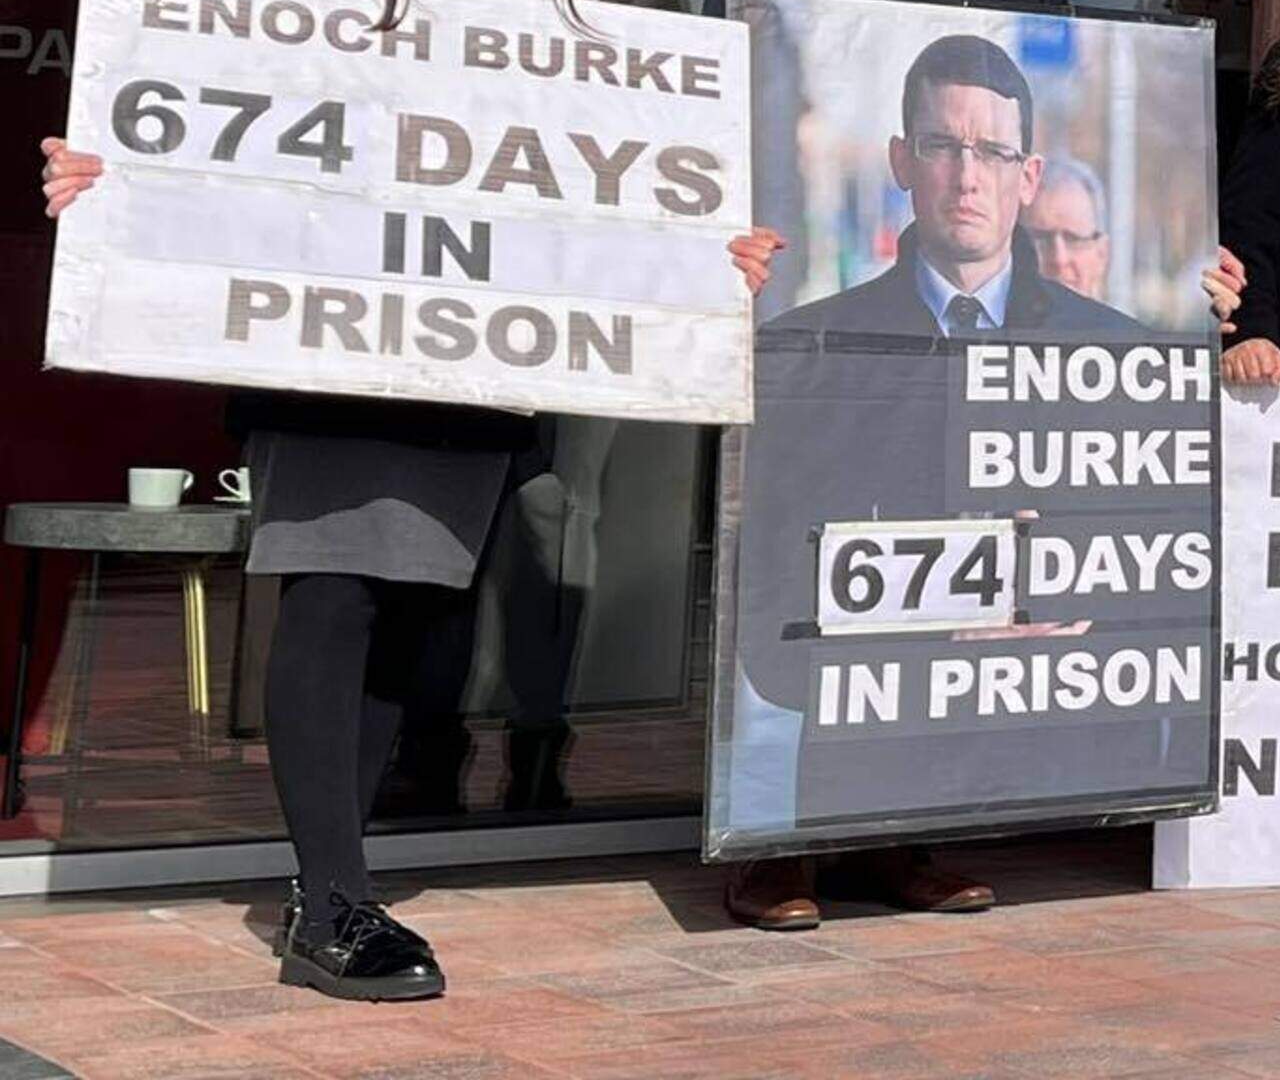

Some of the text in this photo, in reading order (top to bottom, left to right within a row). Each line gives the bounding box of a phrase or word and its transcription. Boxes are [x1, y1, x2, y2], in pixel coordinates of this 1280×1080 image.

[0, 24, 73, 77] PA
[463, 25, 722, 100] BURKE
[111, 80, 724, 218] 674 DAYS
[382, 211, 493, 283] IN
[223, 278, 634, 377] PRISON
[965, 345, 1211, 402] ENOCH
[968, 430, 1212, 488] BURKE
[830, 532, 1213, 614] 674 DAYS
[819, 646, 1201, 725] IN PRISON
[1222, 738, 1278, 796] N
